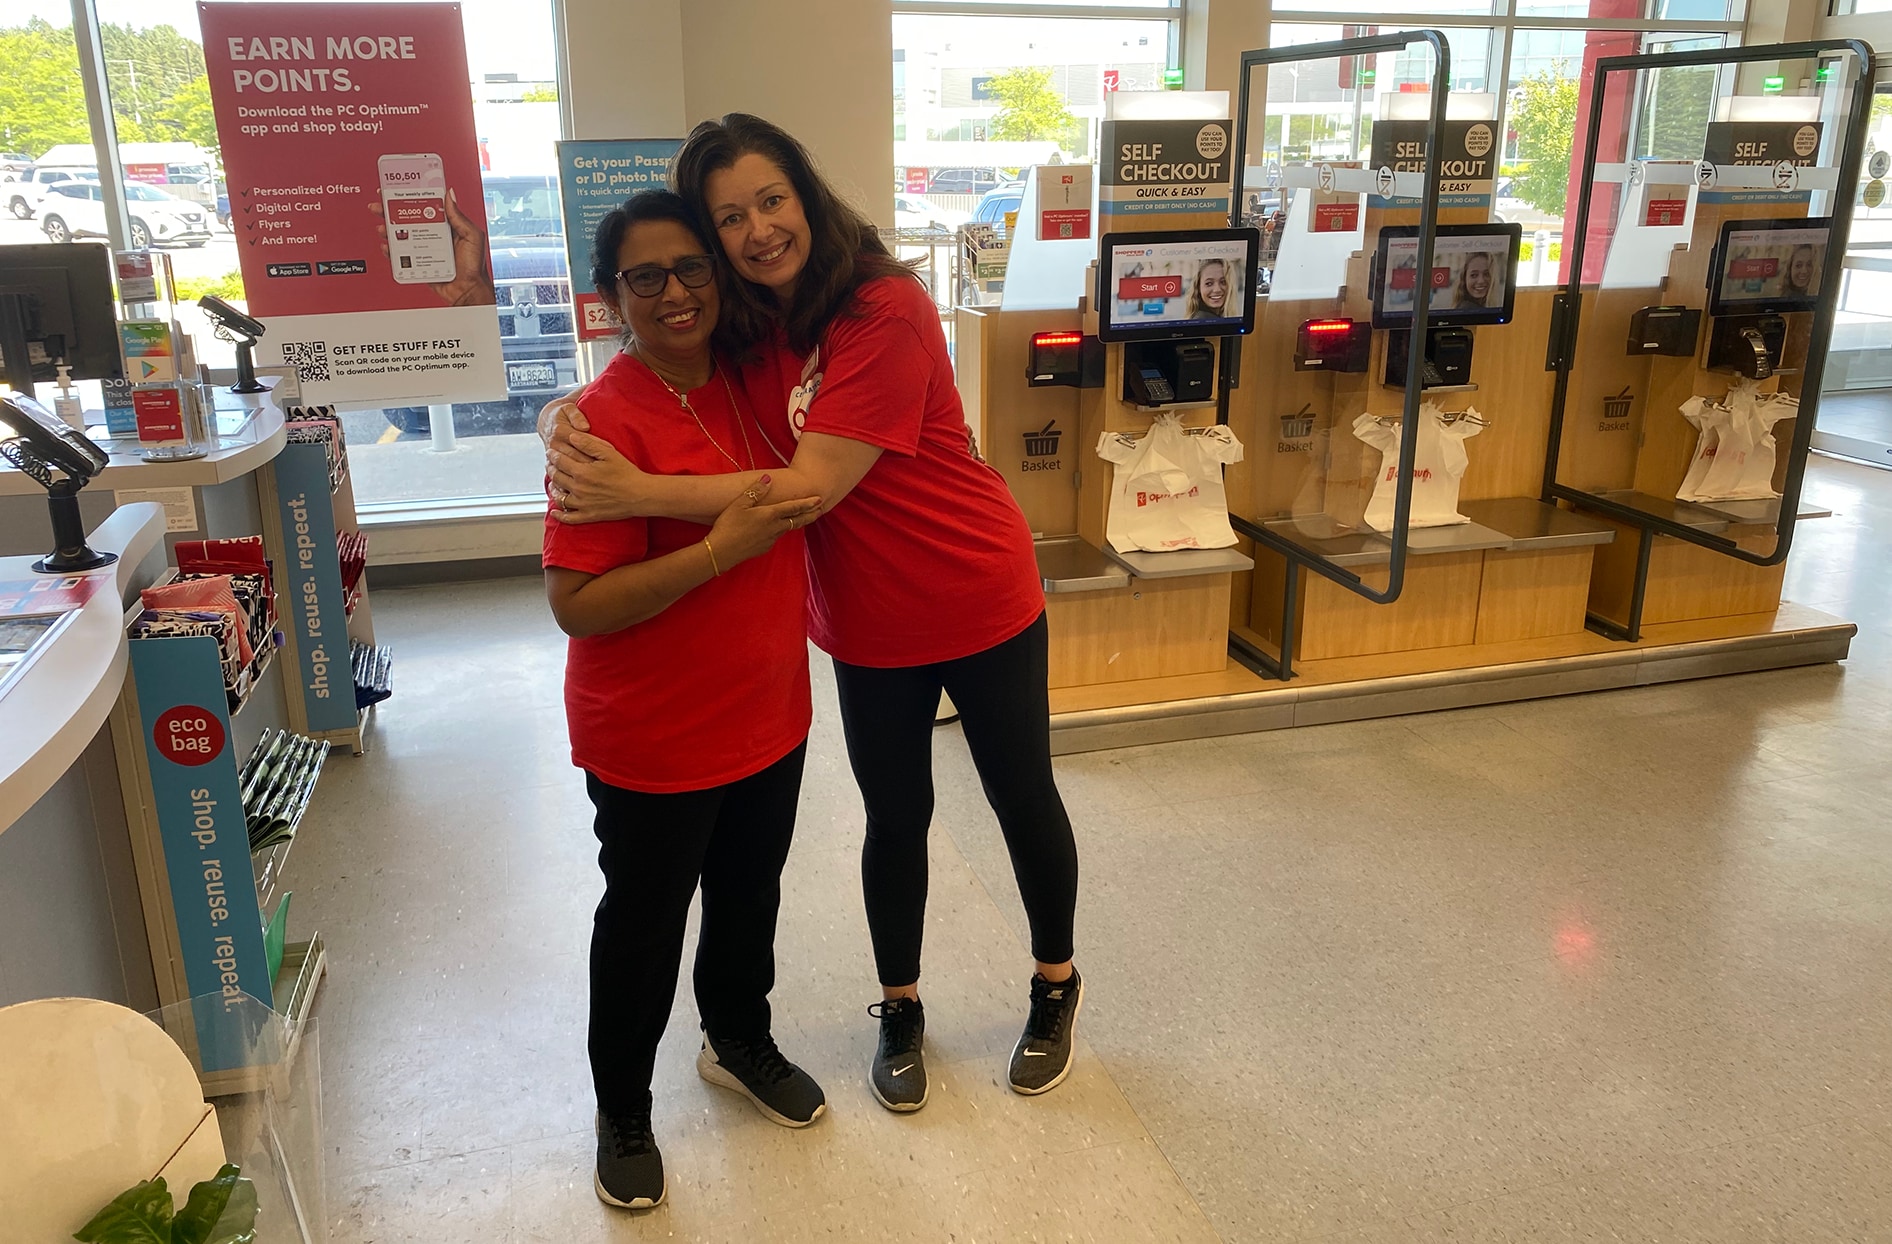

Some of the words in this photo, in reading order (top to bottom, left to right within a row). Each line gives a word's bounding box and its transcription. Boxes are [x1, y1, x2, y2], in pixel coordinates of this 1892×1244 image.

[227, 36, 315, 61] EARN
[326, 36, 417, 60] MORE
[233, 67, 361, 93] POINTS.
[238, 104, 307, 118] Download
[310, 104, 334, 117] the
[337, 104, 355, 117] PC
[241, 122, 268, 136] app
[272, 121, 299, 133] and
[303, 120, 336, 135] shop
[340, 119, 384, 134] today!
[1120, 143, 1162, 162] SELF
[1395, 142, 1428, 158] SEL
[1735, 142, 1768, 157] SELF
[574, 156, 598, 168] Get
[602, 159, 631, 171] your
[634, 155, 672, 169] Passp
[1394, 160, 1486, 176] CHKOUT
[384, 172, 421, 181] 150,501
[575, 176, 589, 184] or
[592, 172, 606, 184] ID
[609, 171, 648, 186] photo
[650, 170, 667, 181] he
[1120, 162, 1221, 182] CHECKOUT
[253, 185, 323, 197] Personalized
[326, 184, 361, 195] Offers
[577, 188, 588, 196] It's
[590, 187, 612, 197] quick
[614, 186, 630, 195] and
[1136, 188, 1169, 198] QUICK
[1171, 187, 1178, 197] &
[1181, 187, 1206, 196] EASY
[1449, 183, 1472, 191] EASY
[256, 203, 292, 216] Digital
[295, 202, 322, 212] Card
[398, 208, 422, 216] 20,000
[258, 219, 292, 232] Flyers
[261, 235, 283, 246] And
[286, 234, 318, 245] more!
[1160, 248, 1192, 257] Customer
[1746, 264, 1760, 272] Start
[1141, 284, 1159, 292] Start
[588, 308, 607, 323] $2
[333, 346, 356, 355] GET
[360, 343, 389, 354] FREE
[392, 341, 428, 352] STUFF
[432, 339, 461, 349] FAST
[403, 355, 421, 363] your
[450, 351, 475, 359] device
[347, 366, 385, 375] download
[387, 365, 400, 373] the
[414, 363, 451, 372] Optimum
[452, 362, 470, 370] app.
[1599, 421, 1630, 432] Basket
[1277, 440, 1314, 453] Basket
[1021, 459, 1061, 472] Basket
[288, 493, 317, 569] repeat.
[300, 576, 322, 638] reuse.
[309, 644, 330, 699] shop.
[168, 718, 207, 733] eco
[170, 734, 212, 754] bag
[190, 788, 217, 850] shop.
[202, 858, 229, 927] reuse.
[214, 935, 248, 1013] repeat.
